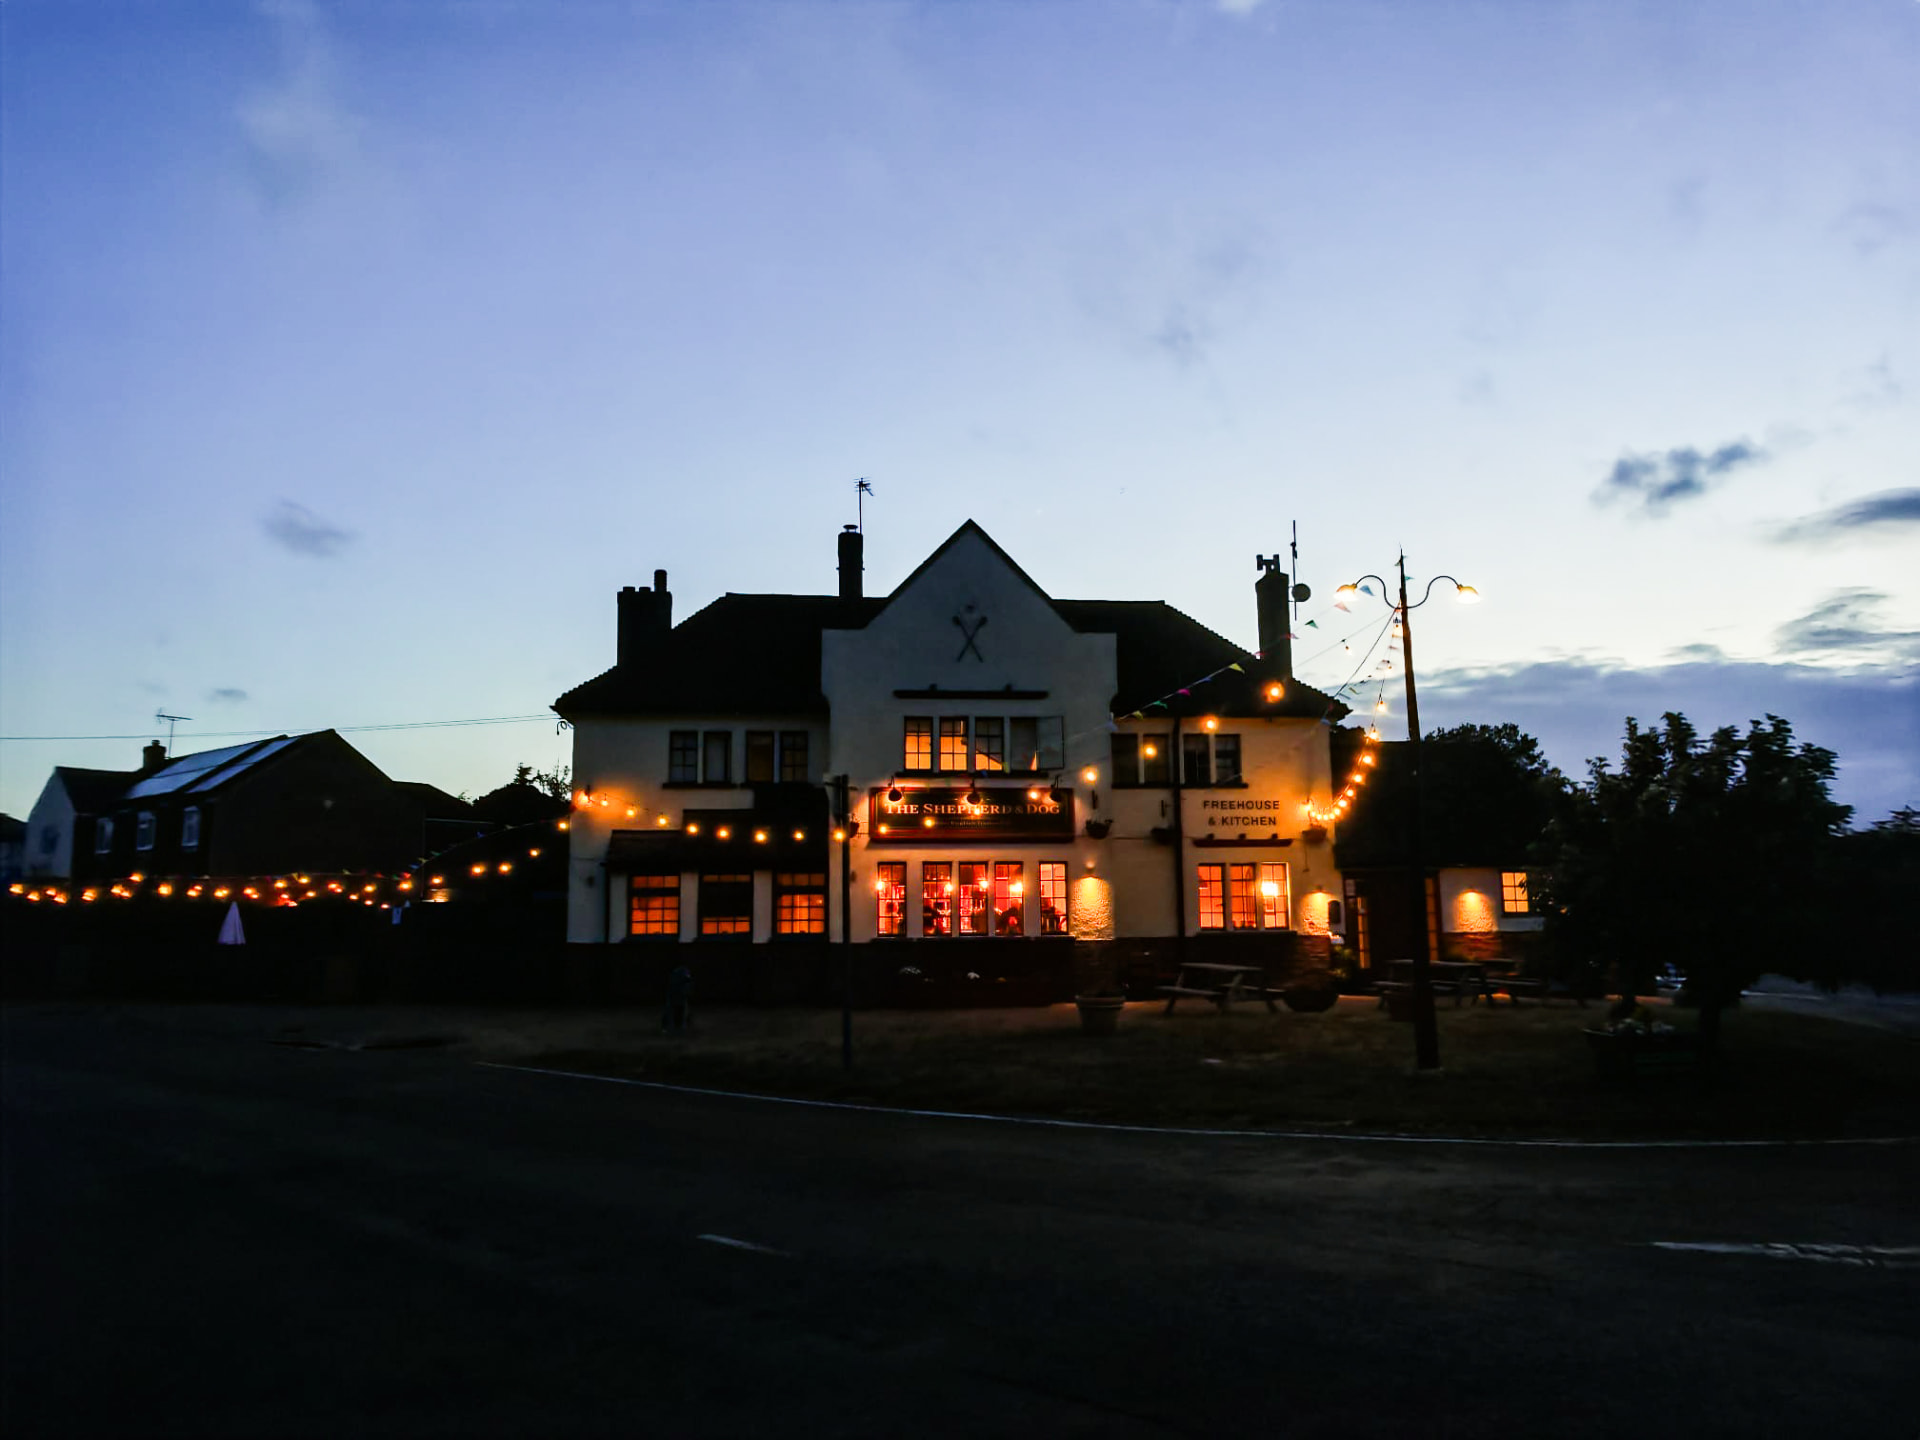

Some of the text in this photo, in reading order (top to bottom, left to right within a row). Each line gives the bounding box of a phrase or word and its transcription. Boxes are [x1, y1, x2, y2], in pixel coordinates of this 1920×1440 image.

[885, 803, 1060, 815] THE SHEPHERD & DOG
[1203, 800, 1280, 810] FREEHOUSE
[1208, 816, 1277, 826] & KITCHEN
